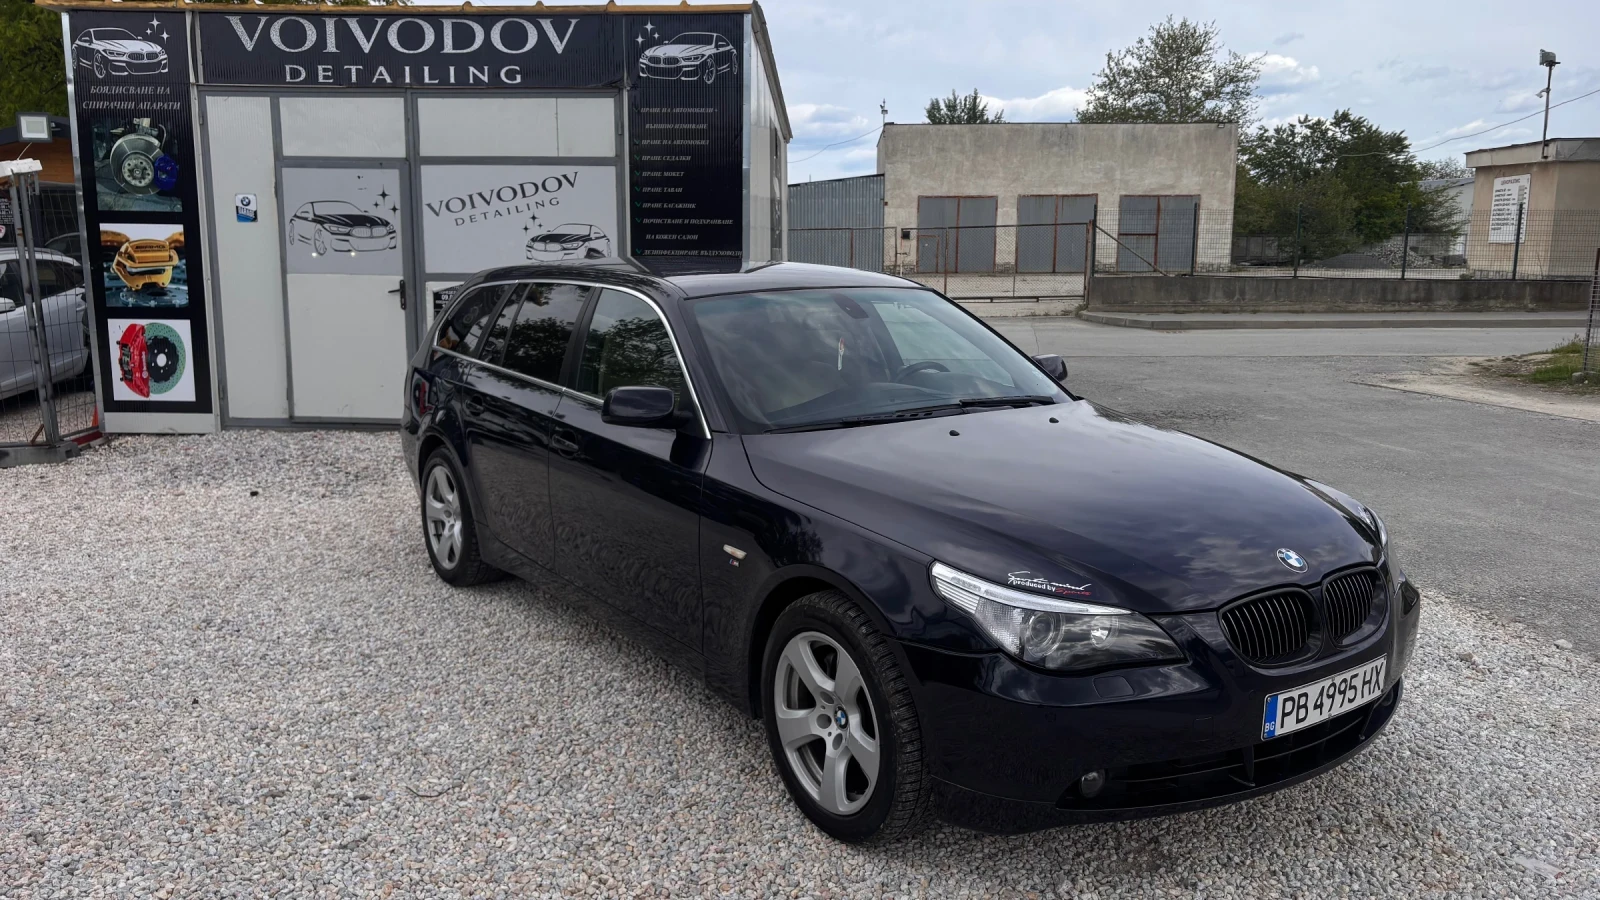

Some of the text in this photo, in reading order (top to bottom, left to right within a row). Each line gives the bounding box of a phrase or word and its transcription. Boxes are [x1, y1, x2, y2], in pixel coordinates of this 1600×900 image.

[224, 15, 582, 55] VOIVODOV
[284, 64, 523, 85] DETAILING
[90, 85, 170, 95] БОЯДИСВАНЕ НА
[82, 100, 181, 110] СПИРАЧНИ АПАРАТИ
[425, 171, 579, 218] VOIVODOV
[454, 197, 560, 226] DETAILING
[1012, 580, 1046, 590] produced
[1047, 584, 1056, 592] by
[1280, 662, 1384, 729] PB 4995 HX
[1264, 722, 1275, 732] BG
